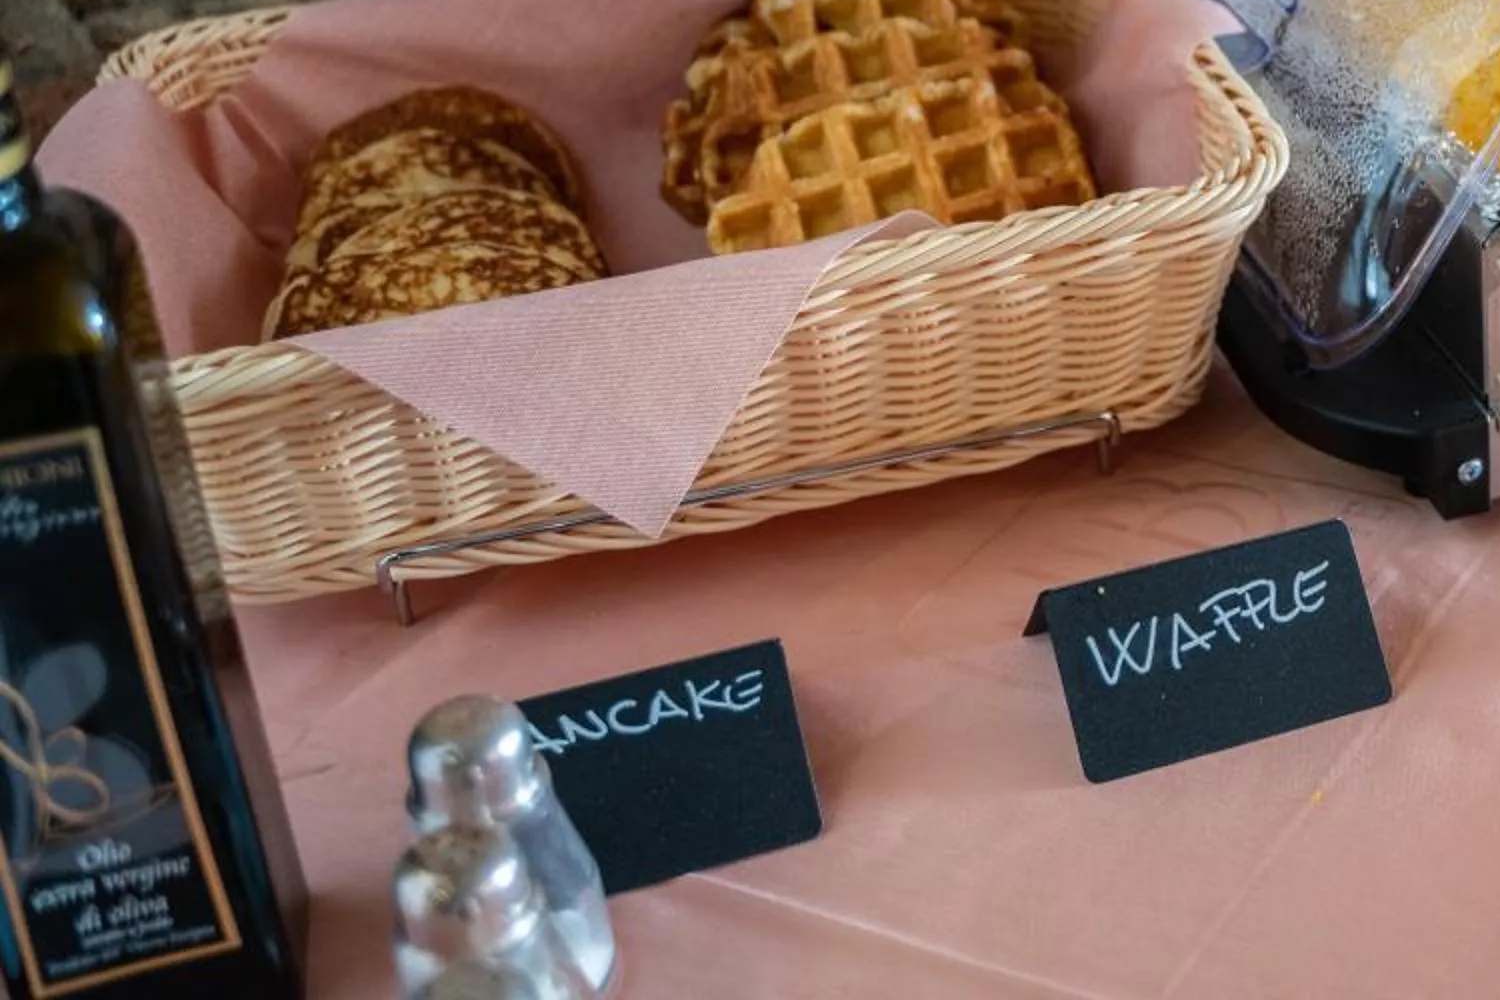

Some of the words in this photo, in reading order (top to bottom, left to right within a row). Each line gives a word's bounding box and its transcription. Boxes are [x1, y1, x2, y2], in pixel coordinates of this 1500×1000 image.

[1086, 560, 1330, 686] WAFFLE
[527, 669, 763, 755] ANCAKE
[76, 837, 132, 872] Olio
[101, 856, 190, 892] vergine
